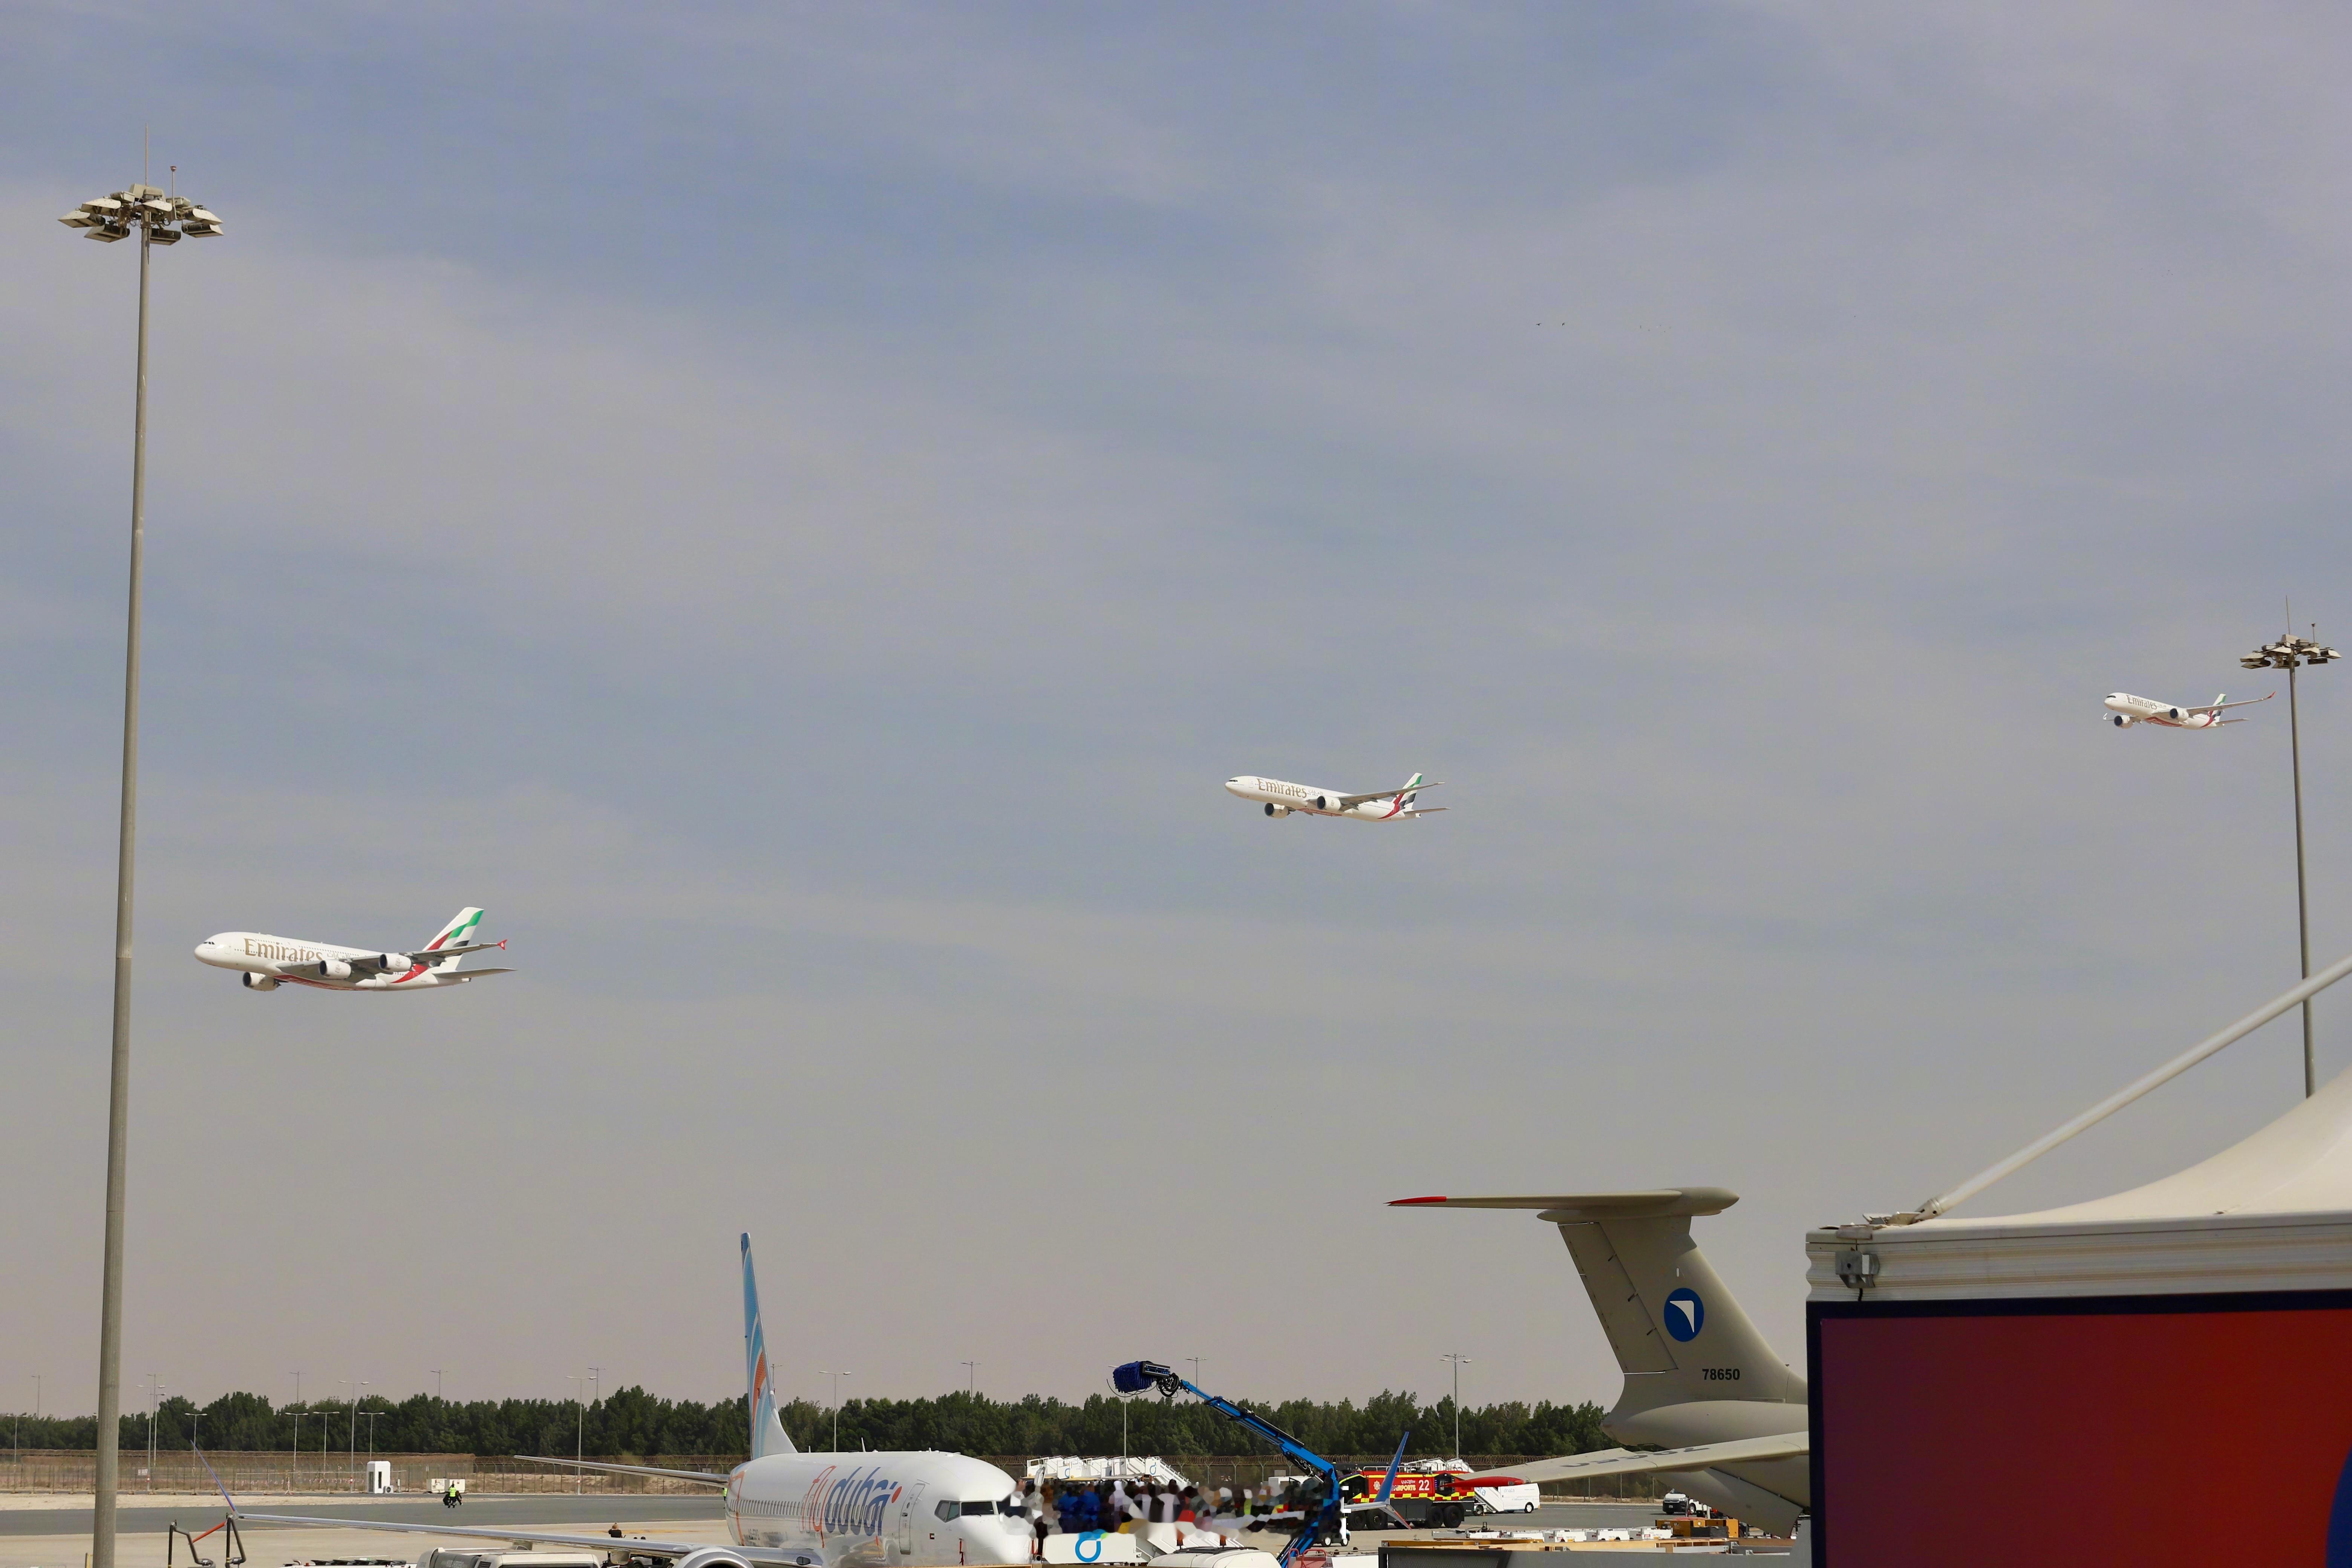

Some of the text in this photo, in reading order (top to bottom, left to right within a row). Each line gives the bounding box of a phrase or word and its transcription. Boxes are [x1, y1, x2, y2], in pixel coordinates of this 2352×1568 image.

[2126, 695, 2157, 710] Emirates
[1257, 778, 1307, 798] Emirates
[243, 938, 323, 962] Emirates
[1702, 1369, 1740, 1380] 78650
[1418, 1479, 1430, 1491] 22
[802, 1465, 902, 1548] flydubai
